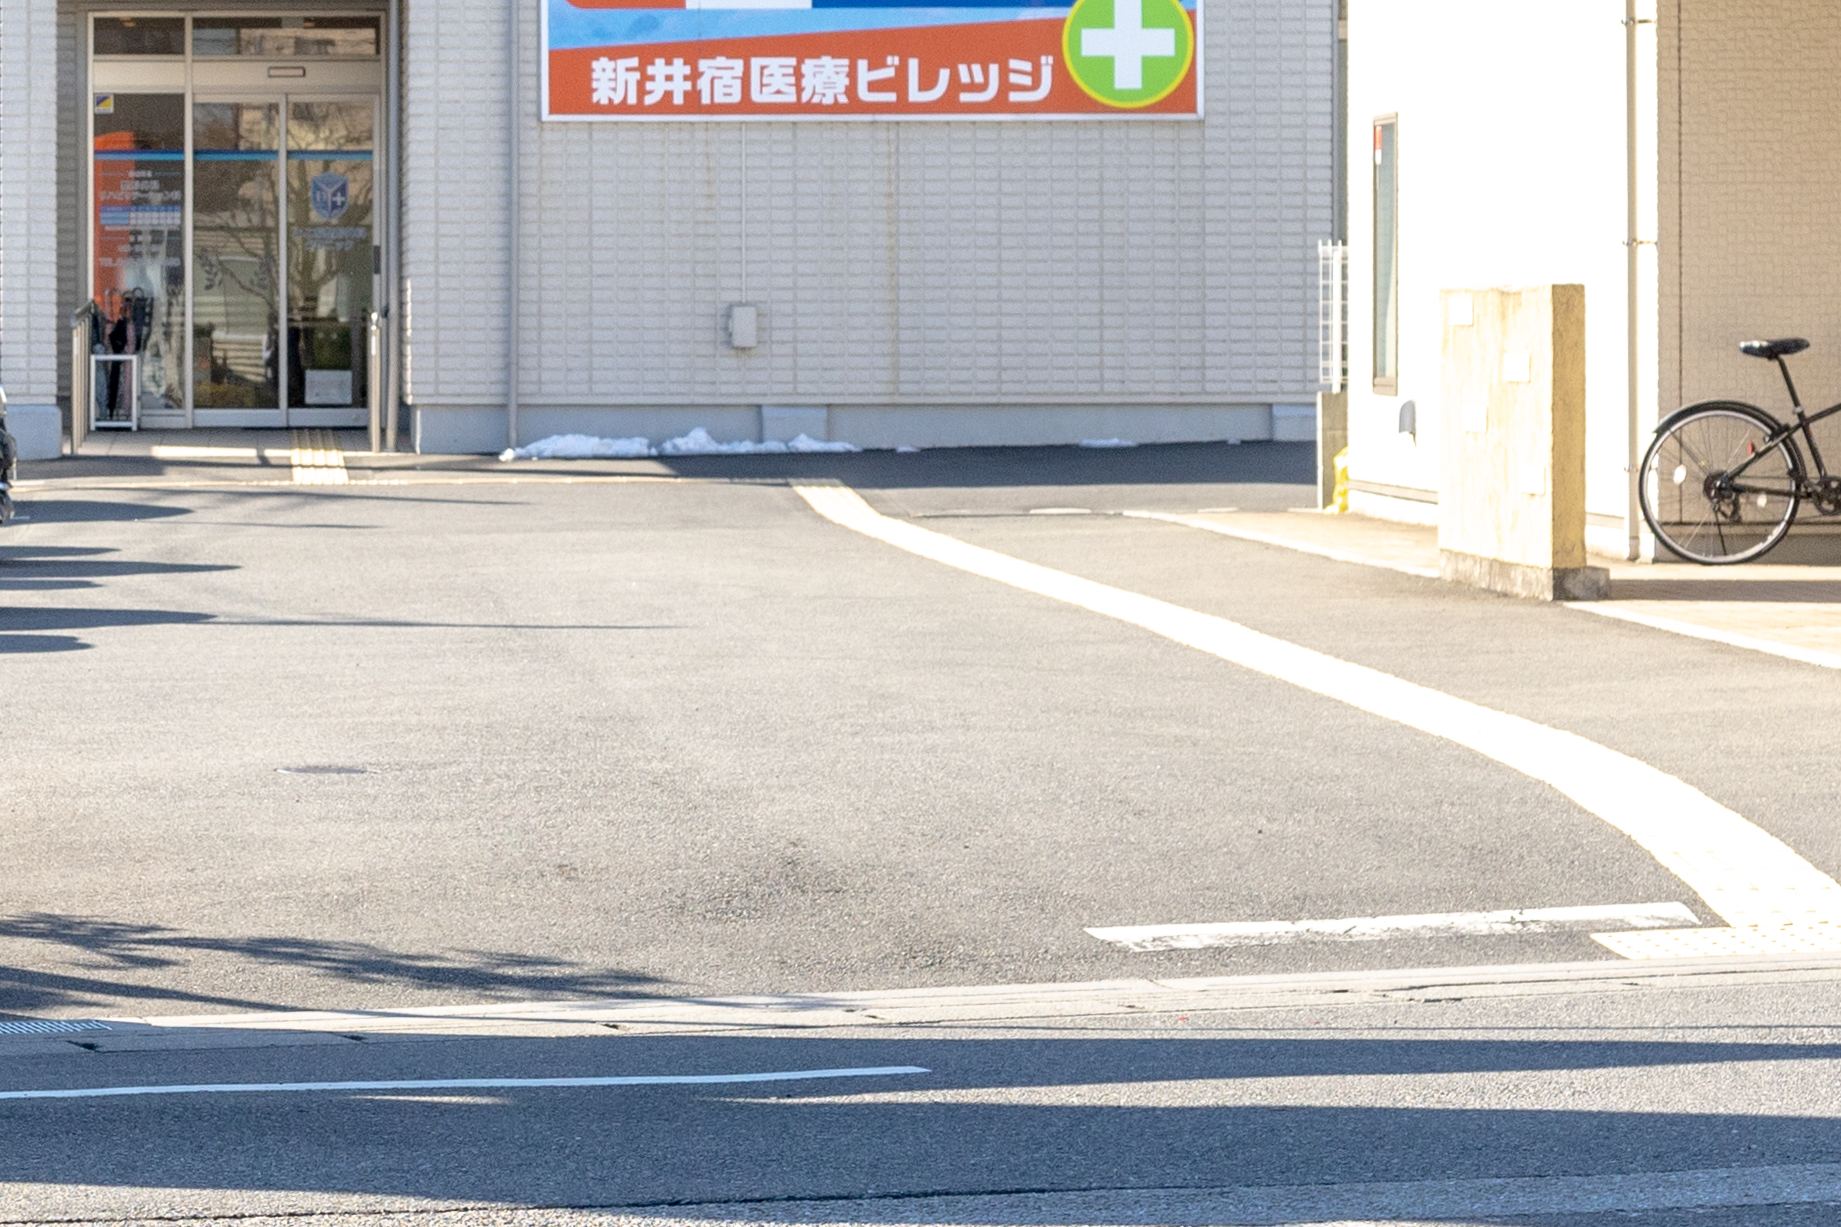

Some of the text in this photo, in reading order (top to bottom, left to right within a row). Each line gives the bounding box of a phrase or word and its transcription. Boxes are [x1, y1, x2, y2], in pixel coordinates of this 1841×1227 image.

[591, 55, 1054, 105] 新井宿医療ビレッジ
